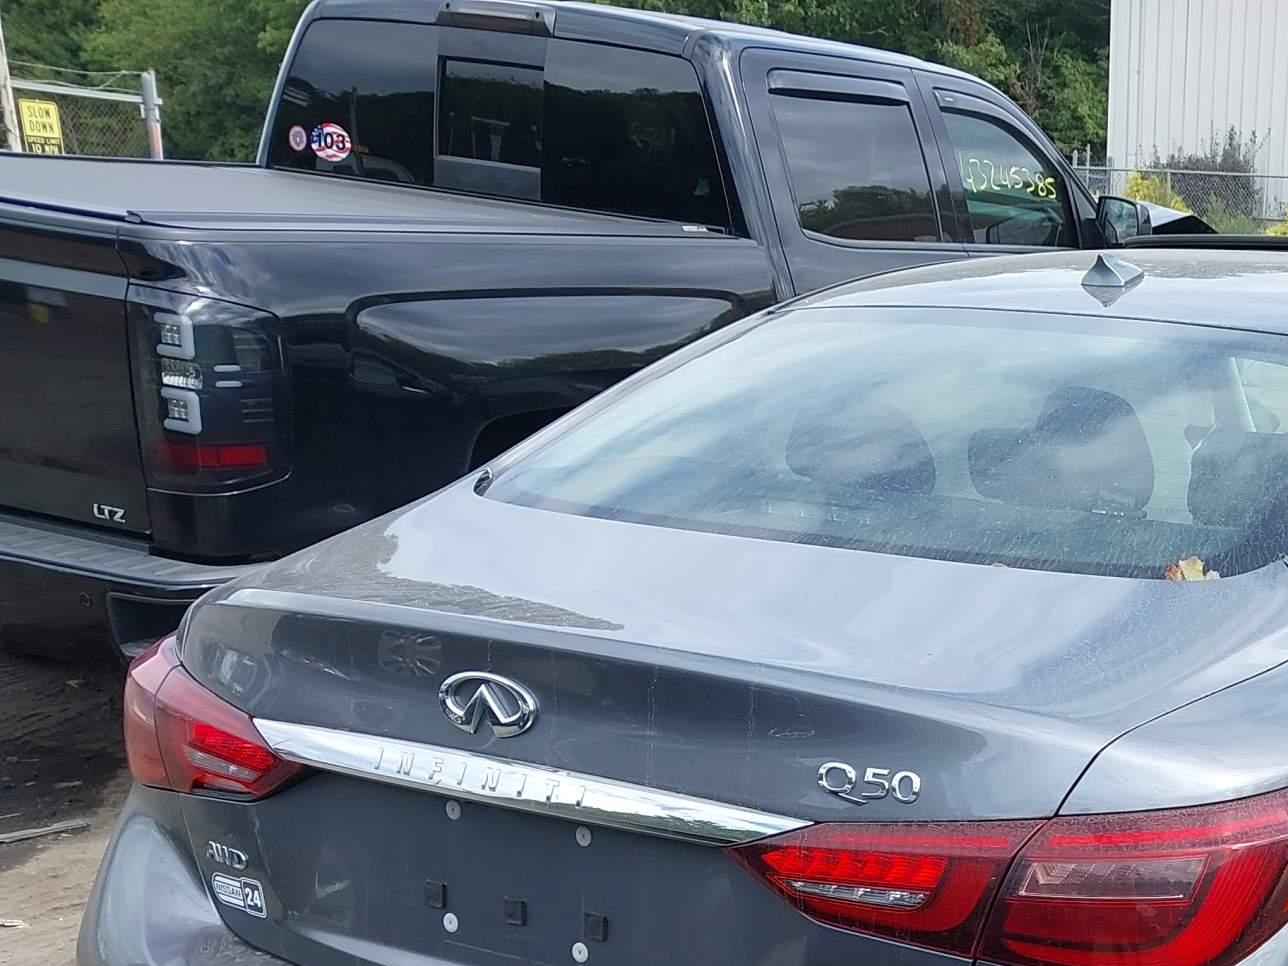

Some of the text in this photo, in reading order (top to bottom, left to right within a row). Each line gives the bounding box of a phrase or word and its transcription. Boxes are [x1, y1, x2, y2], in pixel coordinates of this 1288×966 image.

[26, 104, 51, 119] SLOW
[29, 120, 55, 133] DOWN
[31, 143, 42, 154] 10
[317, 131, 346, 151] 103
[93, 503, 126, 523] LTZ
[373, 746, 588, 808] INFINITI
[816, 760, 922, 807] Q50
[206, 840, 249, 870] AWD
[214, 881, 262, 908] NISSAN 24
